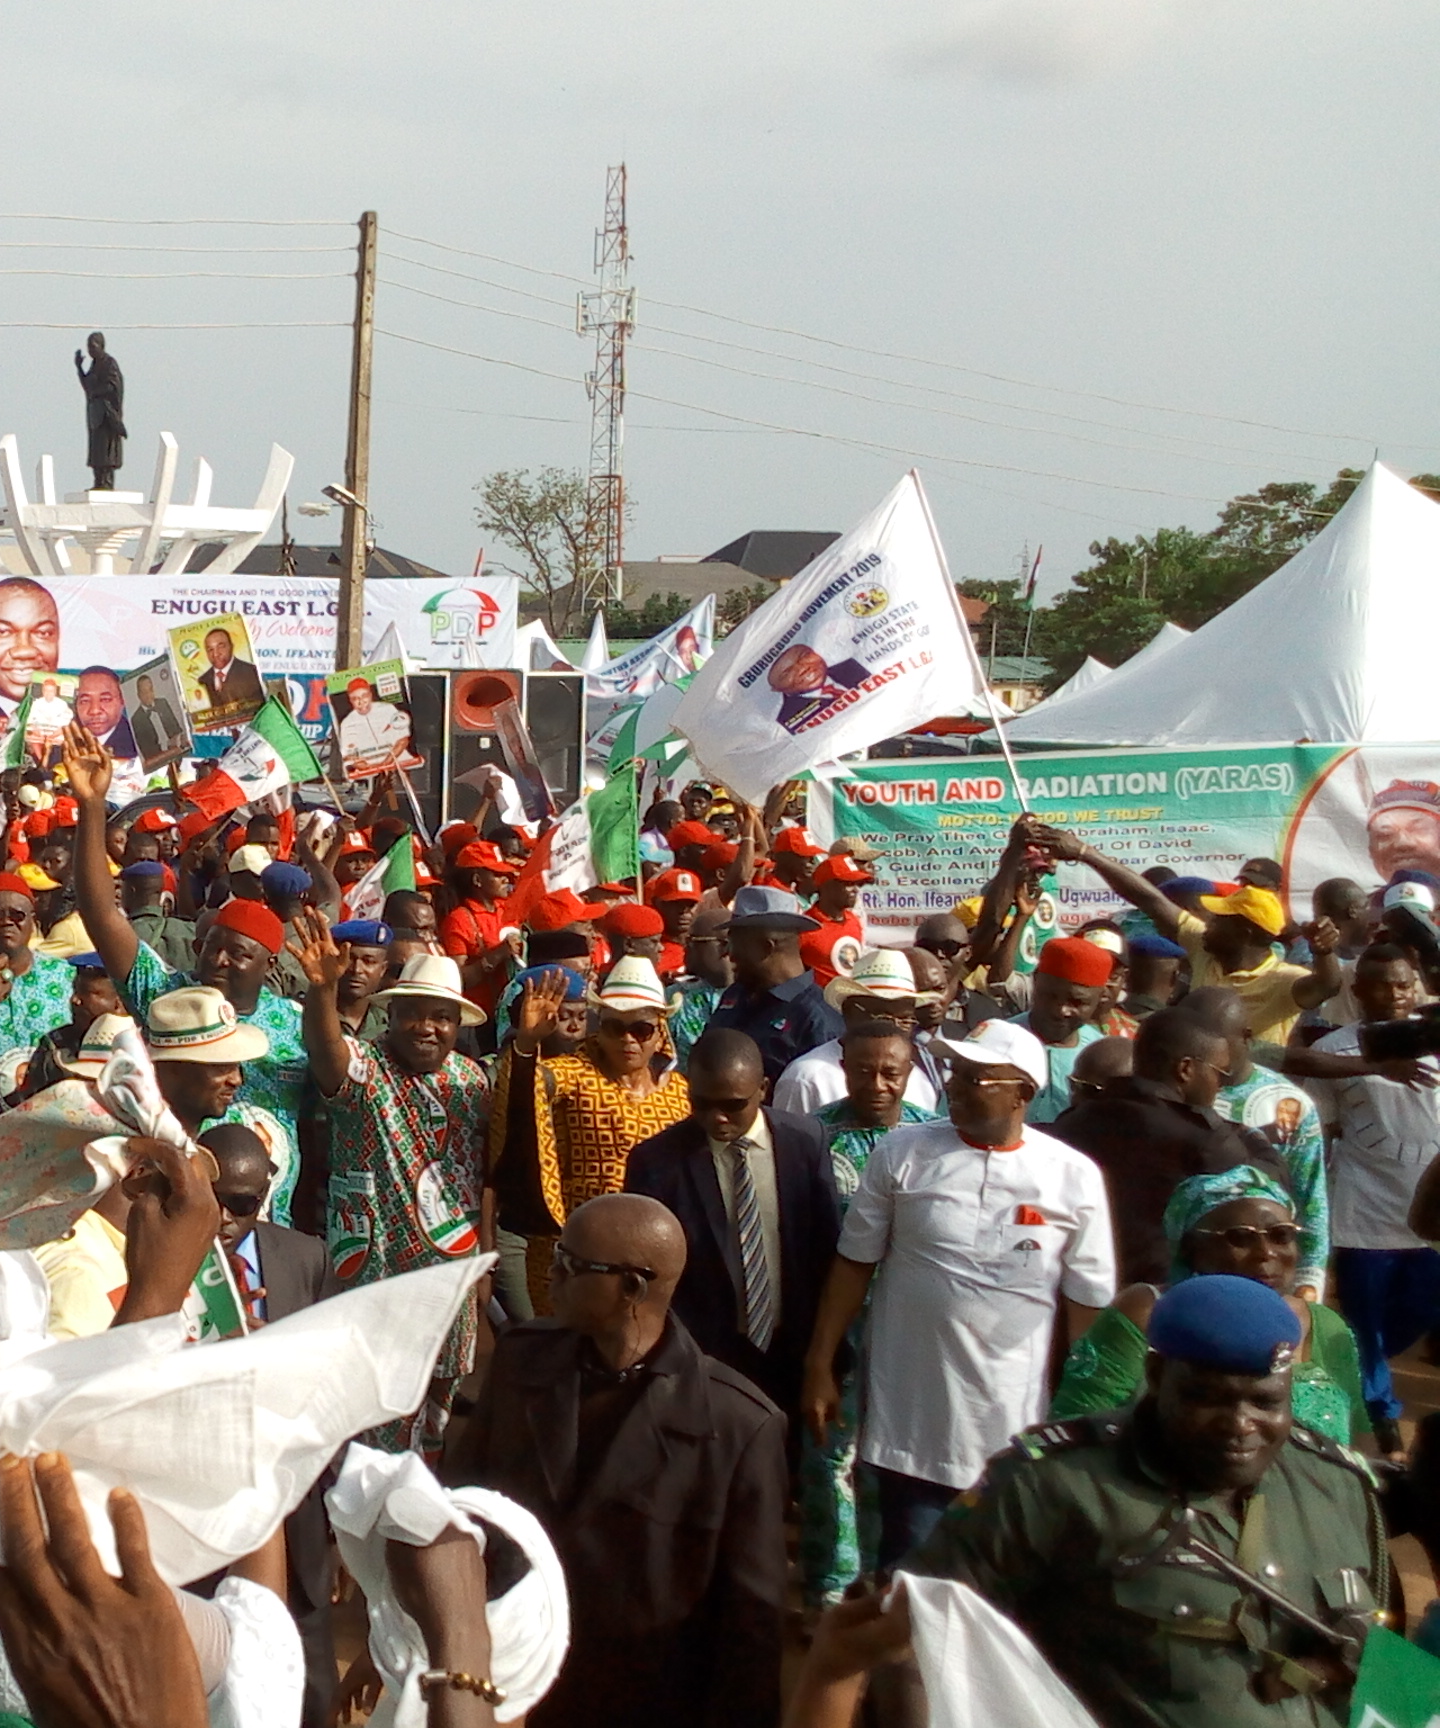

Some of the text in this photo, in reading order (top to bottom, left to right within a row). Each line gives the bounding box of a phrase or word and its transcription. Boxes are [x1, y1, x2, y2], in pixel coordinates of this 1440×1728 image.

[801, 572, 854, 624] MOVEMENT
[850, 552, 882, 578] 2019
[152, 600, 235, 615] ENUGU
[242, 600, 300, 615] EAST
[268, 619, 335, 638] Welcome
[431, 611, 496, 639] PDP
[851, 600, 920, 645] ENUGU STATE
[871, 615, 916, 645] IS IN THE
[138, 647, 156, 655] His
[865, 636, 904, 663] HANDS
[271, 663, 306, 671] ENUGU
[309, 663, 335, 671] STAT
[861, 660, 908, 694] EAST
[841, 778, 937, 805] YOUTH
[944, 777, 1005, 803] AND
[1175, 763, 1294, 800] (YARAS)
[938, 813, 1001, 827] MOTTO:
[1074, 810, 1100, 822] WE
[1104, 807, 1163, 821] TRUST
[860, 834, 889, 843] We
[895, 833, 935, 844] Pray
[942, 831, 986, 841] Thee
[1160, 824, 1216, 833] Isaac,
[926, 847, 964, 856] And
[1111, 839, 1132, 850] Of
[1138, 838, 1193, 849] David
[889, 862, 942, 872] Guide
[948, 861, 986, 870] And
[862, 892, 881, 908] Rt.
[887, 892, 920, 908] Hon.
